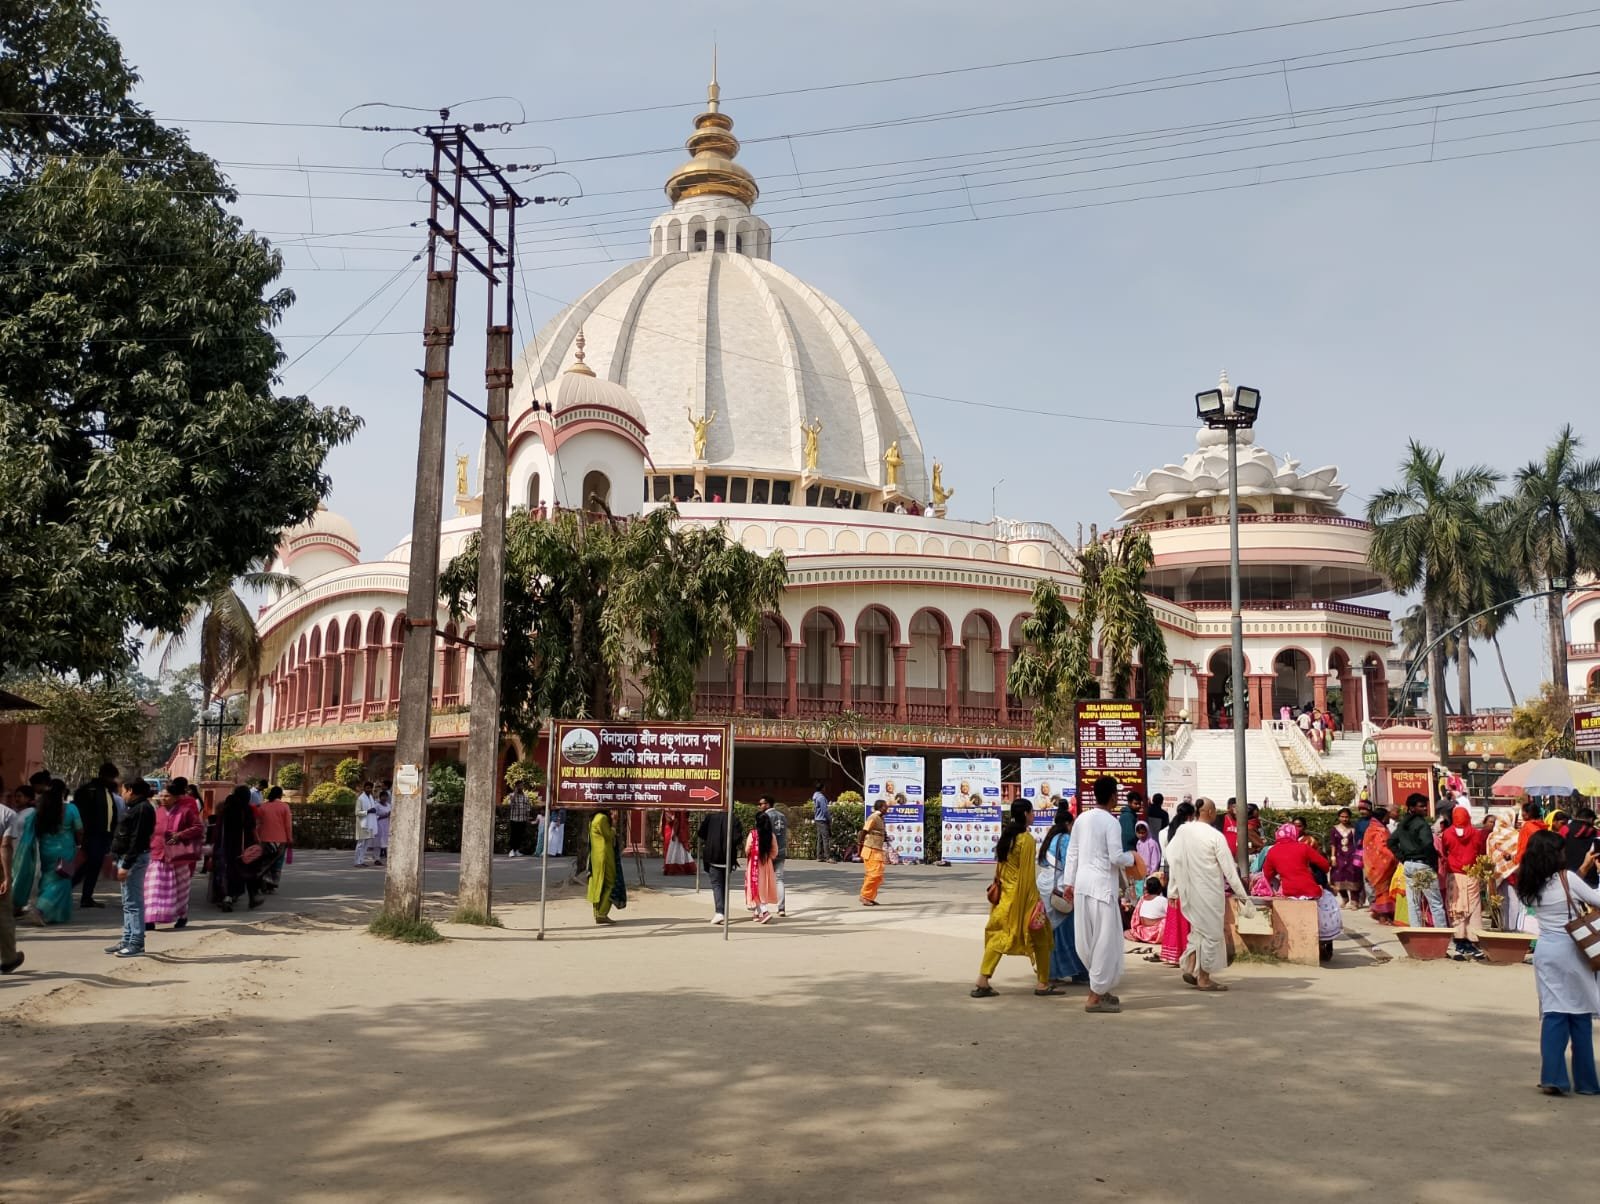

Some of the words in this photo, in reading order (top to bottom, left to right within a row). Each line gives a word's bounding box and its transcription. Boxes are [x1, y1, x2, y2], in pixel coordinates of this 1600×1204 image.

[1581, 718, 1590, 728] NO
[639, 728, 658, 746] শ্রীল
[659, 732, 700, 750] প্রভুপাদের
[637, 748, 660, 766] মন্দির
[661, 748, 680, 766] দর্শন
[1364, 753, 1377, 762] EXIT
[560, 767, 575, 778] VISIT
[575, 767, 589, 778] SRILA
[643, 768, 665, 779] SAMADHI
[685, 768, 708, 780] WITHOUT
[708, 769, 721, 780] FEES
